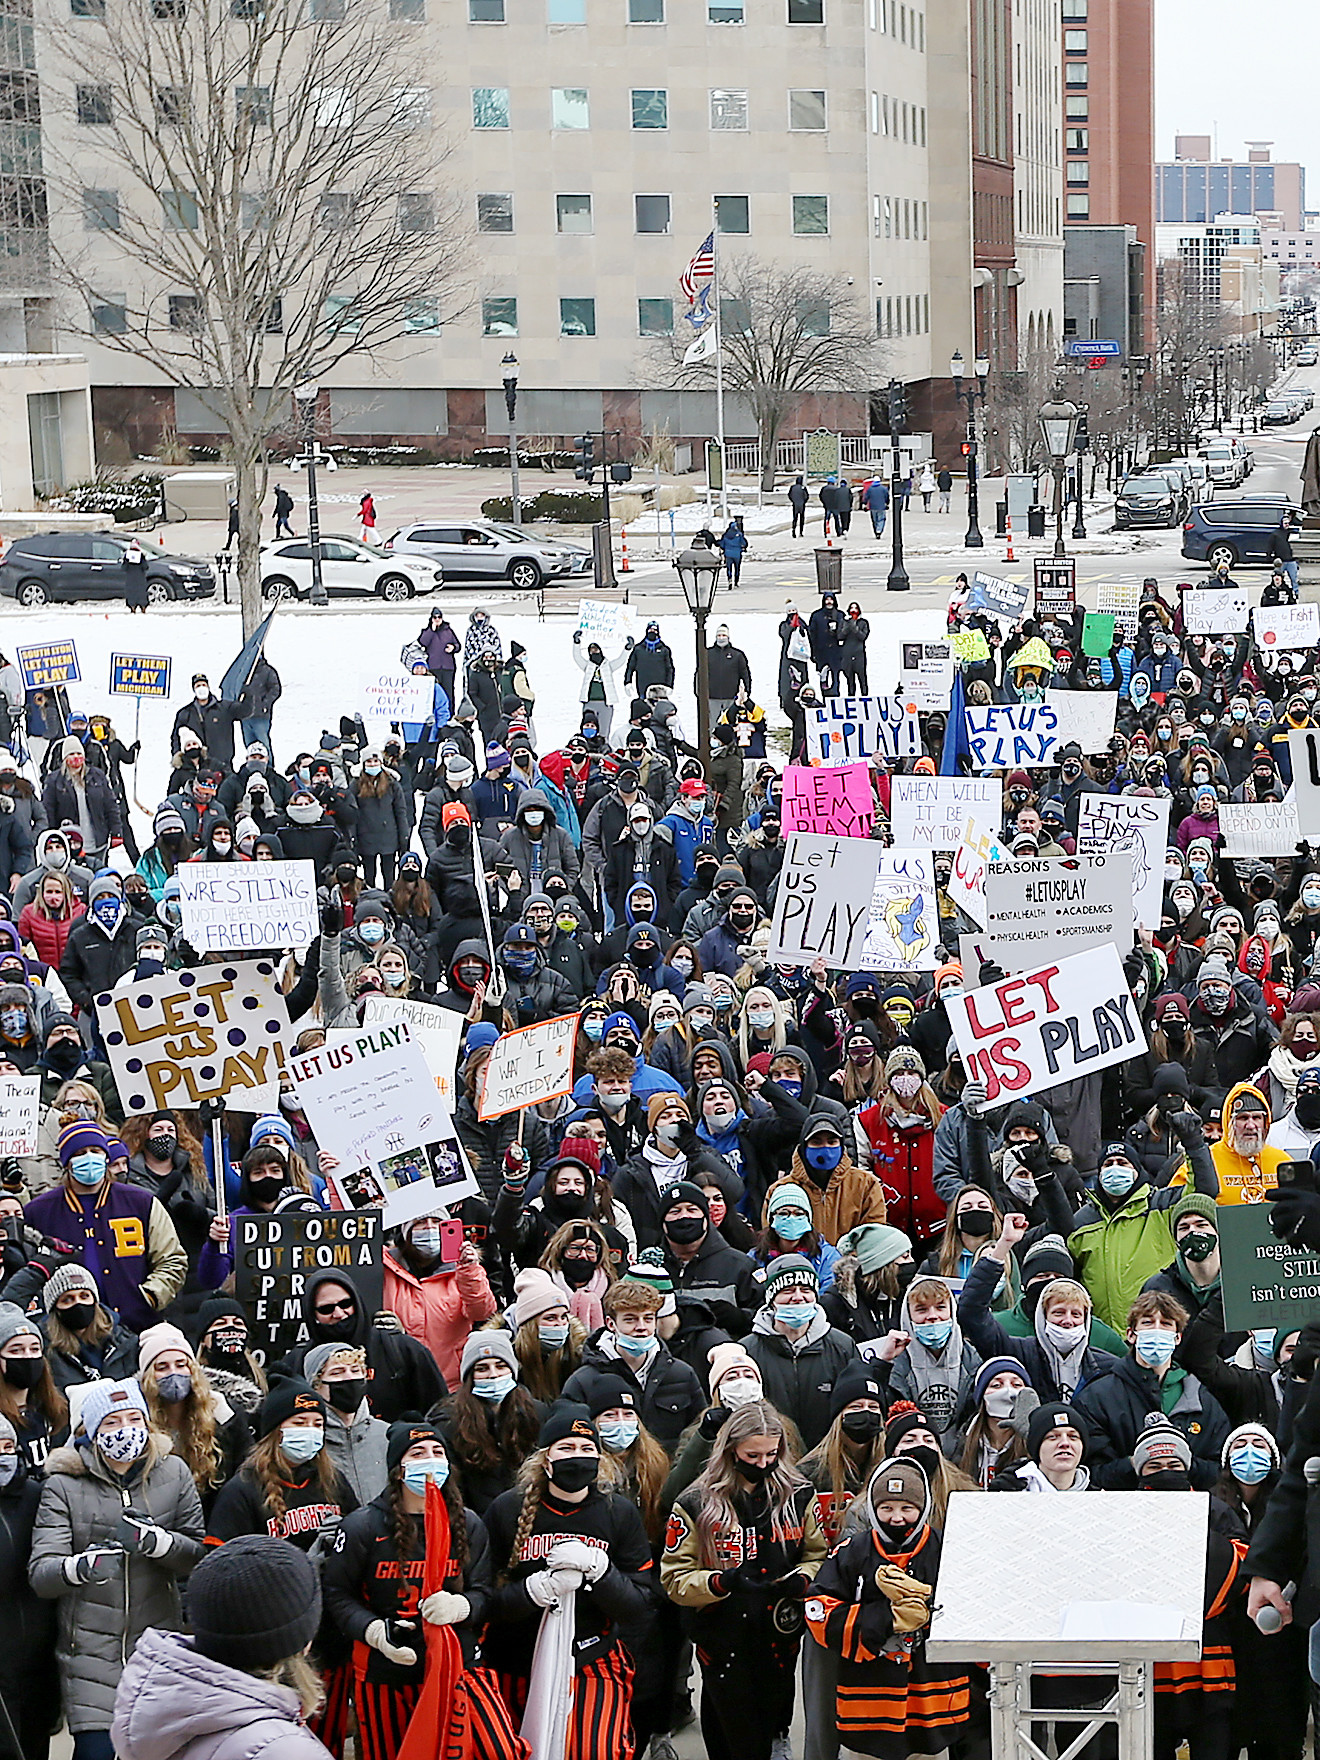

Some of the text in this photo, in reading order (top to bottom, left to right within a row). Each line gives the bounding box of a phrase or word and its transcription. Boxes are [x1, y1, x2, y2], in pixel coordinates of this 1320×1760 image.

[1186, 591, 1206, 601] Let
[1186, 604, 1201, 616] Us
[1257, 611, 1277, 623] Here
[1186, 617, 1214, 632] Play
[24, 654, 72, 669] LET THEM
[116, 657, 166, 669] LET THEM
[33, 666, 69, 684] PLAY
[122, 669, 159, 684] PLAY
[379, 675, 409, 688] OUR
[369, 704, 414, 716] CHOICE!
[378, 696, 404, 705] OUR
[831, 696, 904, 722] LET US
[965, 707, 1015, 734] LET
[1019, 705, 1057, 731] US
[843, 721, 915, 757] PLAY!
[969, 736, 1057, 766] PLAY
[794, 771, 852, 797] LET
[898, 782, 990, 801] WHEN WILL
[786, 797, 856, 818] THEM
[916, 806, 961, 821] IT BE
[1084, 799, 1126, 820] LET
[1222, 803, 1296, 818] THEIR LIVES
[913, 826, 960, 842] MY TUR
[1220, 817, 1295, 832] DEPEND ON IT
[791, 838, 841, 868] Let
[1087, 856, 1106, 867] TO
[187, 863, 300, 878] THEY SHOULD BE
[180, 879, 309, 903] WRESTLING
[1025, 878, 1087, 903] #LETUSPLAY
[191, 900, 317, 922] NOT HERE FIGHTING
[996, 908, 1046, 921] MENTAL HEALTH
[1062, 904, 1113, 917] ACADEMICS
[206, 922, 314, 949] FREEDOMS!
[780, 895, 866, 964] PLAY
[997, 931, 1049, 943] PHYSICAL HEALTH
[1062, 924, 1113, 937] SPORTSMANSHIP
[964, 966, 1060, 1040] LET
[114, 981, 234, 1047] LET
[366, 1000, 442, 1029] Our children
[520, 1029, 536, 1049] ME
[967, 994, 1135, 1101] US PLAY
[291, 1022, 411, 1083] LET US PLAY!
[535, 1050, 545, 1070] I
[145, 1041, 288, 1109] PLAY!
[498, 1073, 552, 1106] STARTED!
[20, 1108, 30, 1117] in
[108, 1217, 145, 1257] B
[342, 1216, 377, 1239] GET
[292, 1244, 352, 1269] FROM
[358, 1244, 373, 1265] A
[1251, 1284, 1286, 1302] isn't
